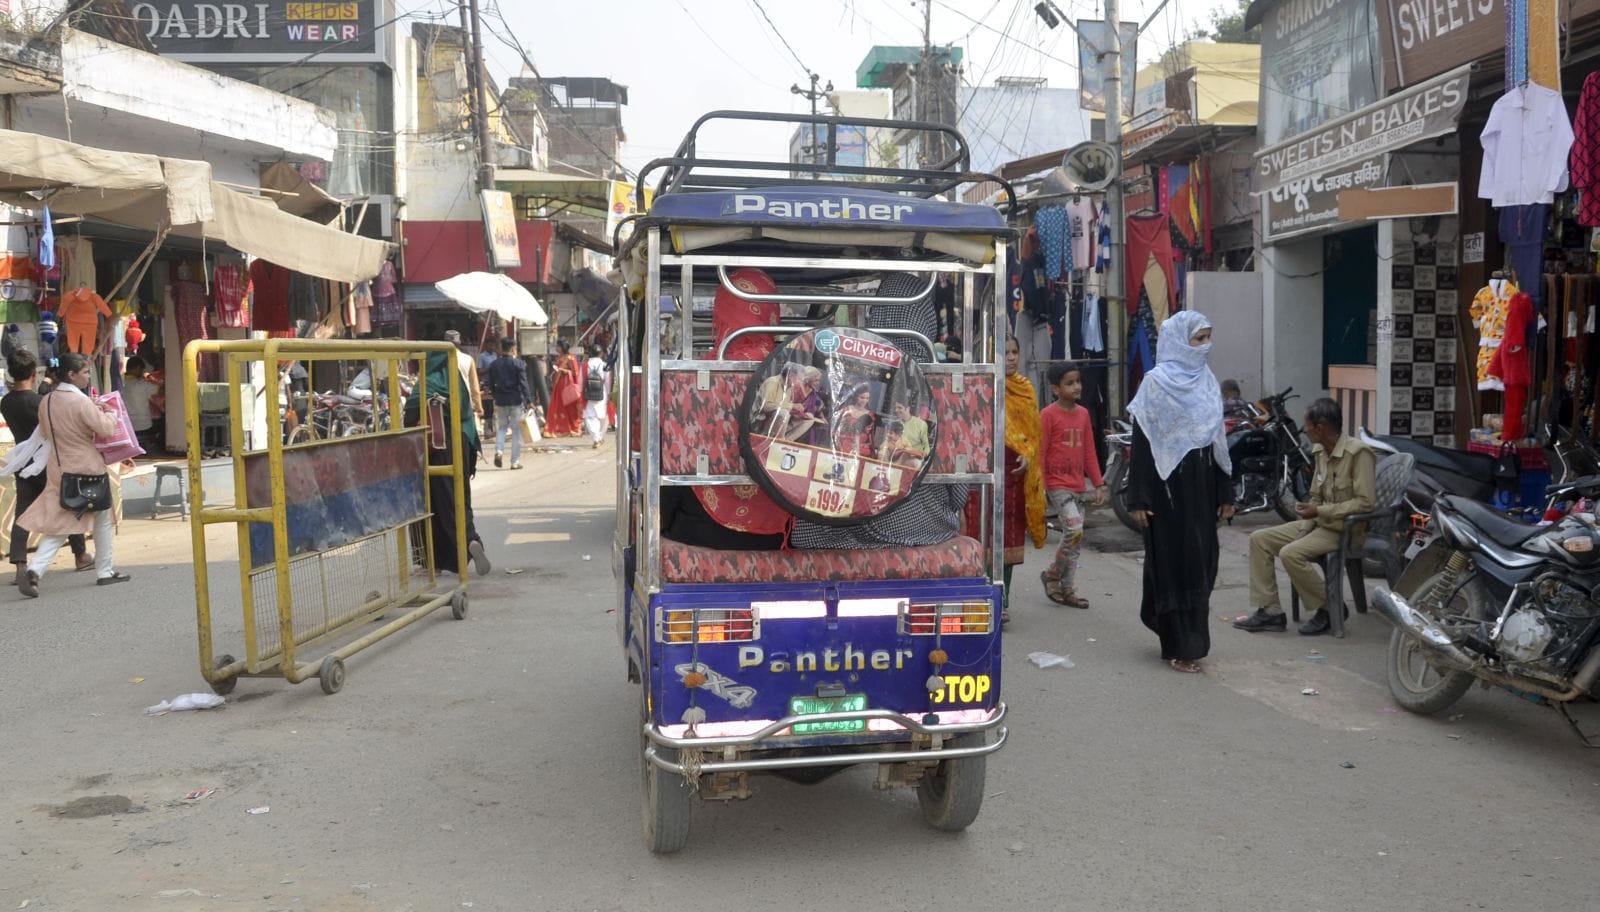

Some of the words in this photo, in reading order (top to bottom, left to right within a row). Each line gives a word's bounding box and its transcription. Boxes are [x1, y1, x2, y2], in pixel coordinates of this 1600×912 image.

[287, 3, 356, 19] KIDS
[1276, 0, 1340, 39] SHAKO
[132, 3, 270, 48] QADRI
[287, 25, 357, 41] WEAR
[1261, 131, 1335, 176] SWEETS
[1371, 79, 1461, 134] BAKES
[735, 194, 913, 222] Panther
[842, 338, 895, 361] Citykart
[738, 644, 913, 672] Panther
